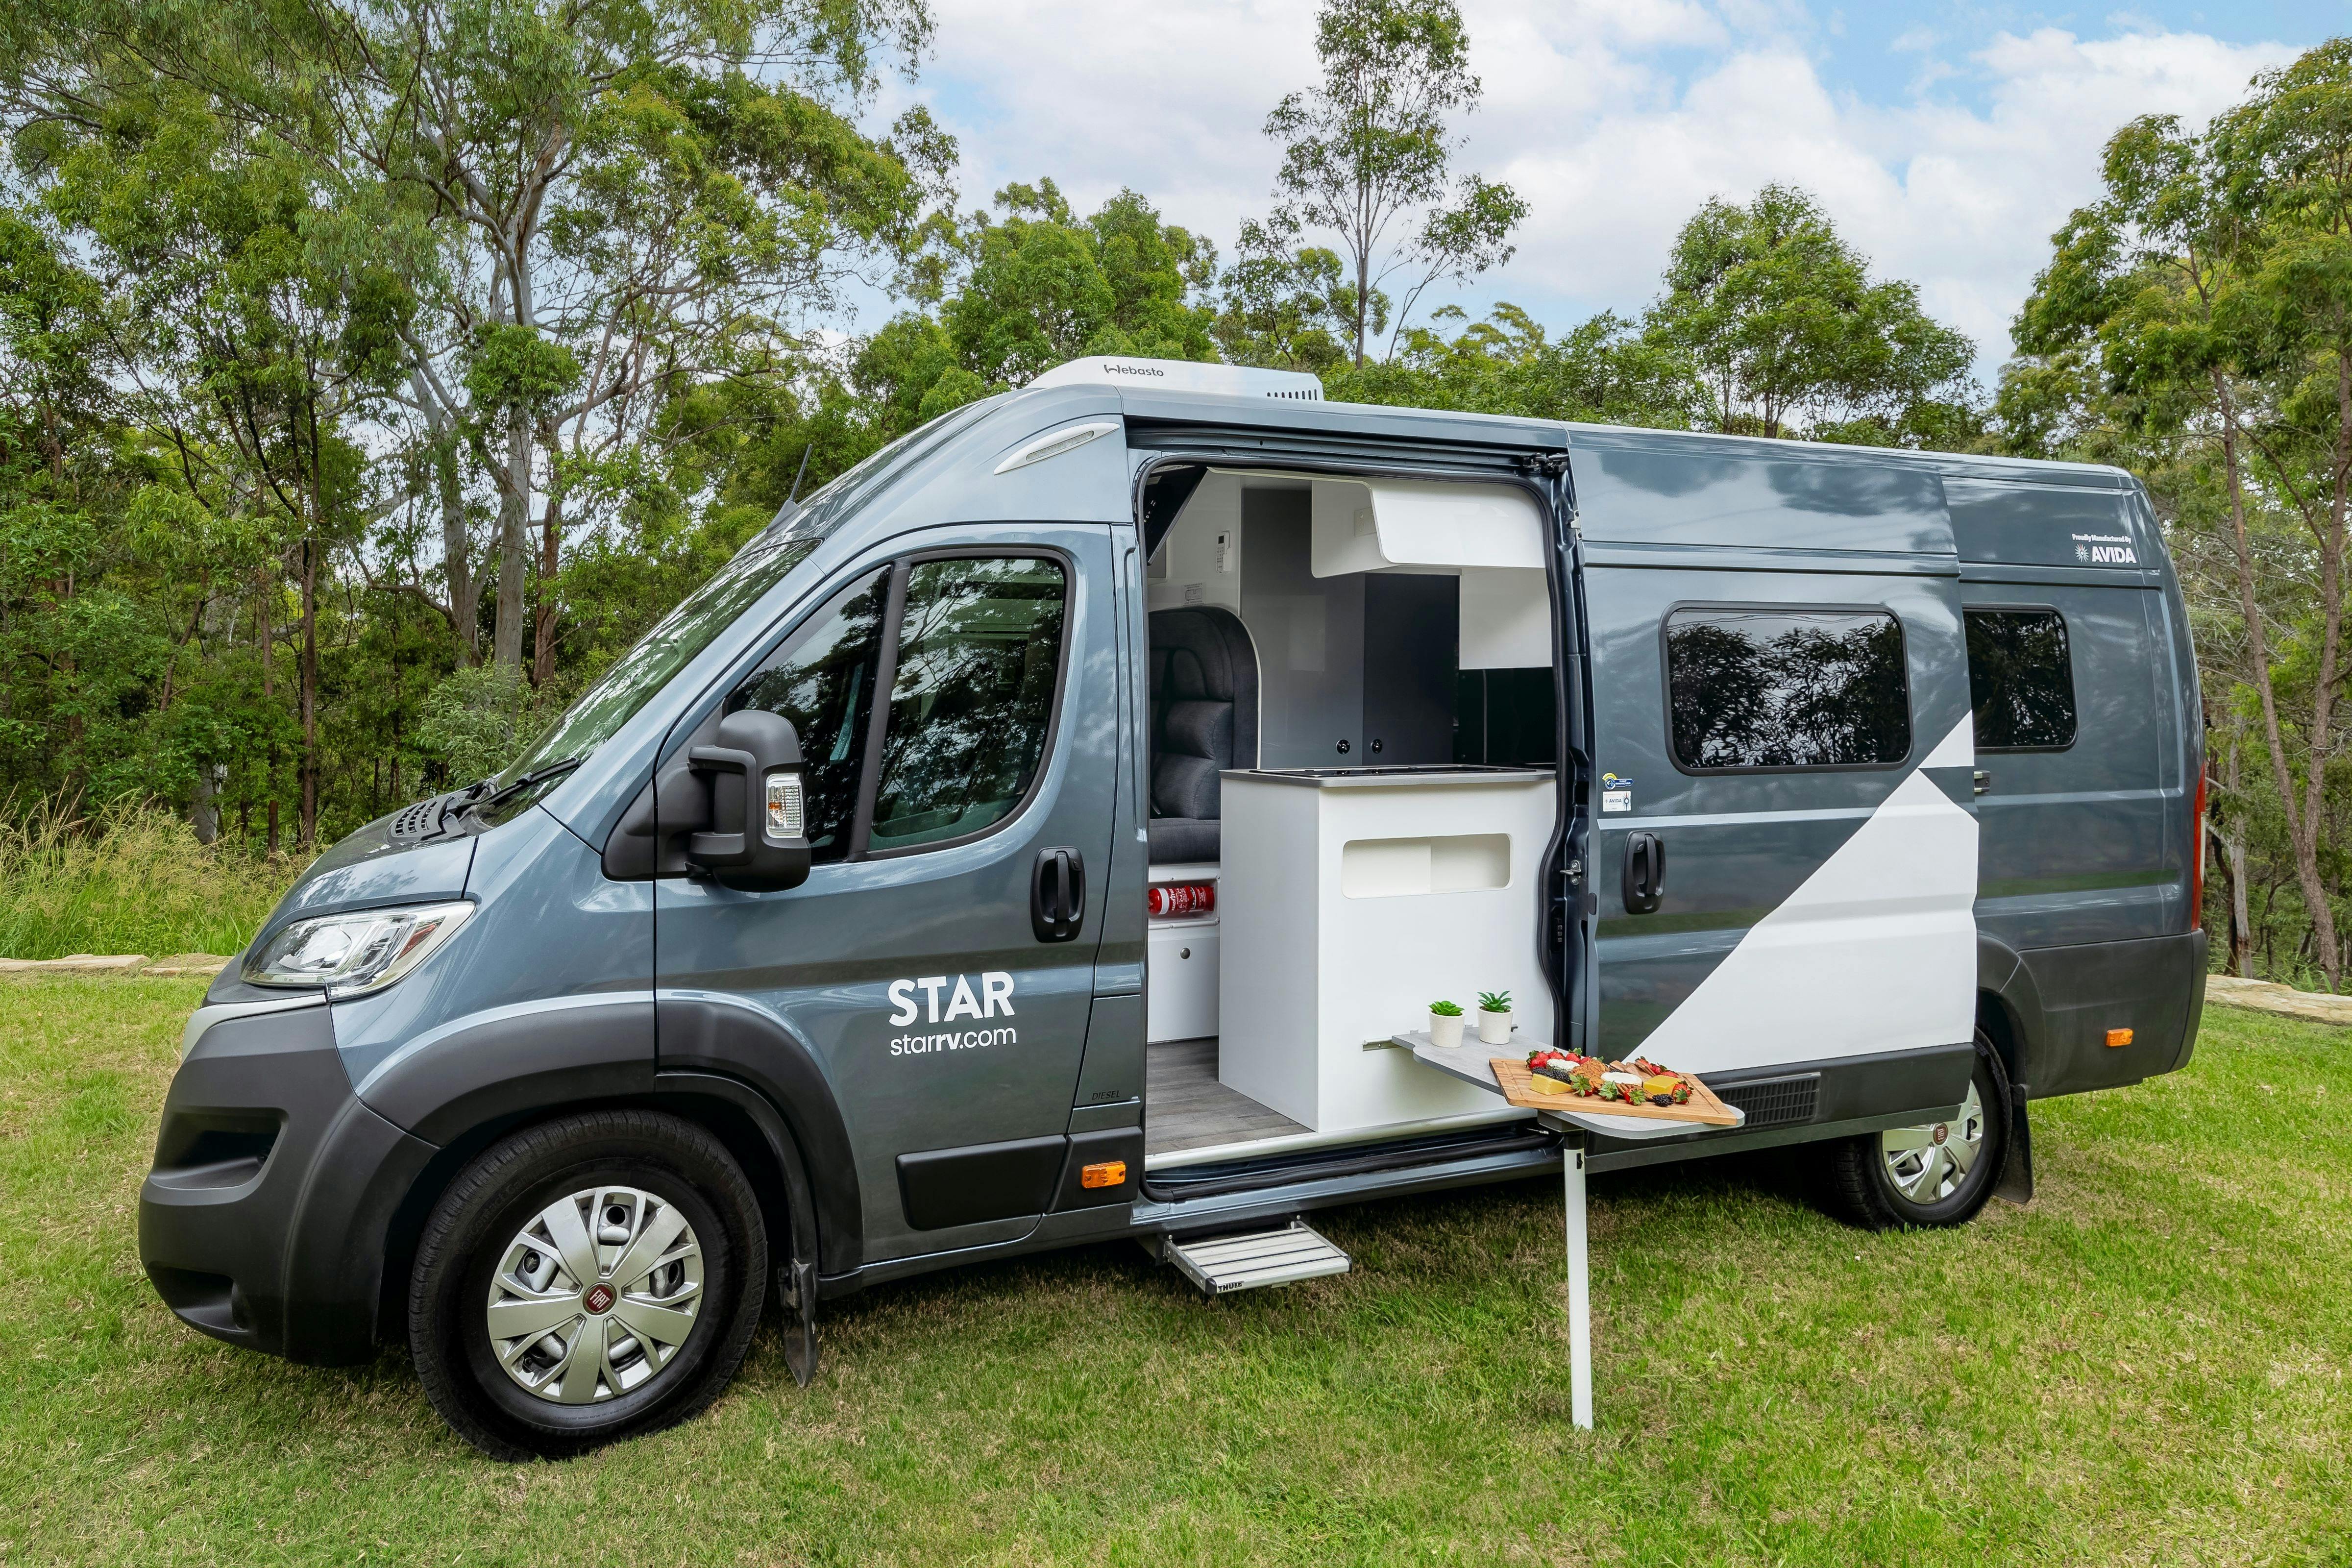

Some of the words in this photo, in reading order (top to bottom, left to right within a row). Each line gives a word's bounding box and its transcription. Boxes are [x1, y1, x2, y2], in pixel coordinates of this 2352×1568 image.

[1104, 365, 1164, 376] Webasto
[2071, 533, 2091, 542] Proudly
[2091, 534, 2125, 542] Manufactured
[2125, 536, 2132, 544] By
[2092, 546, 2137, 564] AVIDA
[888, 971, 1015, 1027] STAR
[890, 1028, 1016, 1056] starrv.com
[1092, 1090, 1120, 1101] DIESEL
[589, 1289, 610, 1308] FIAT
